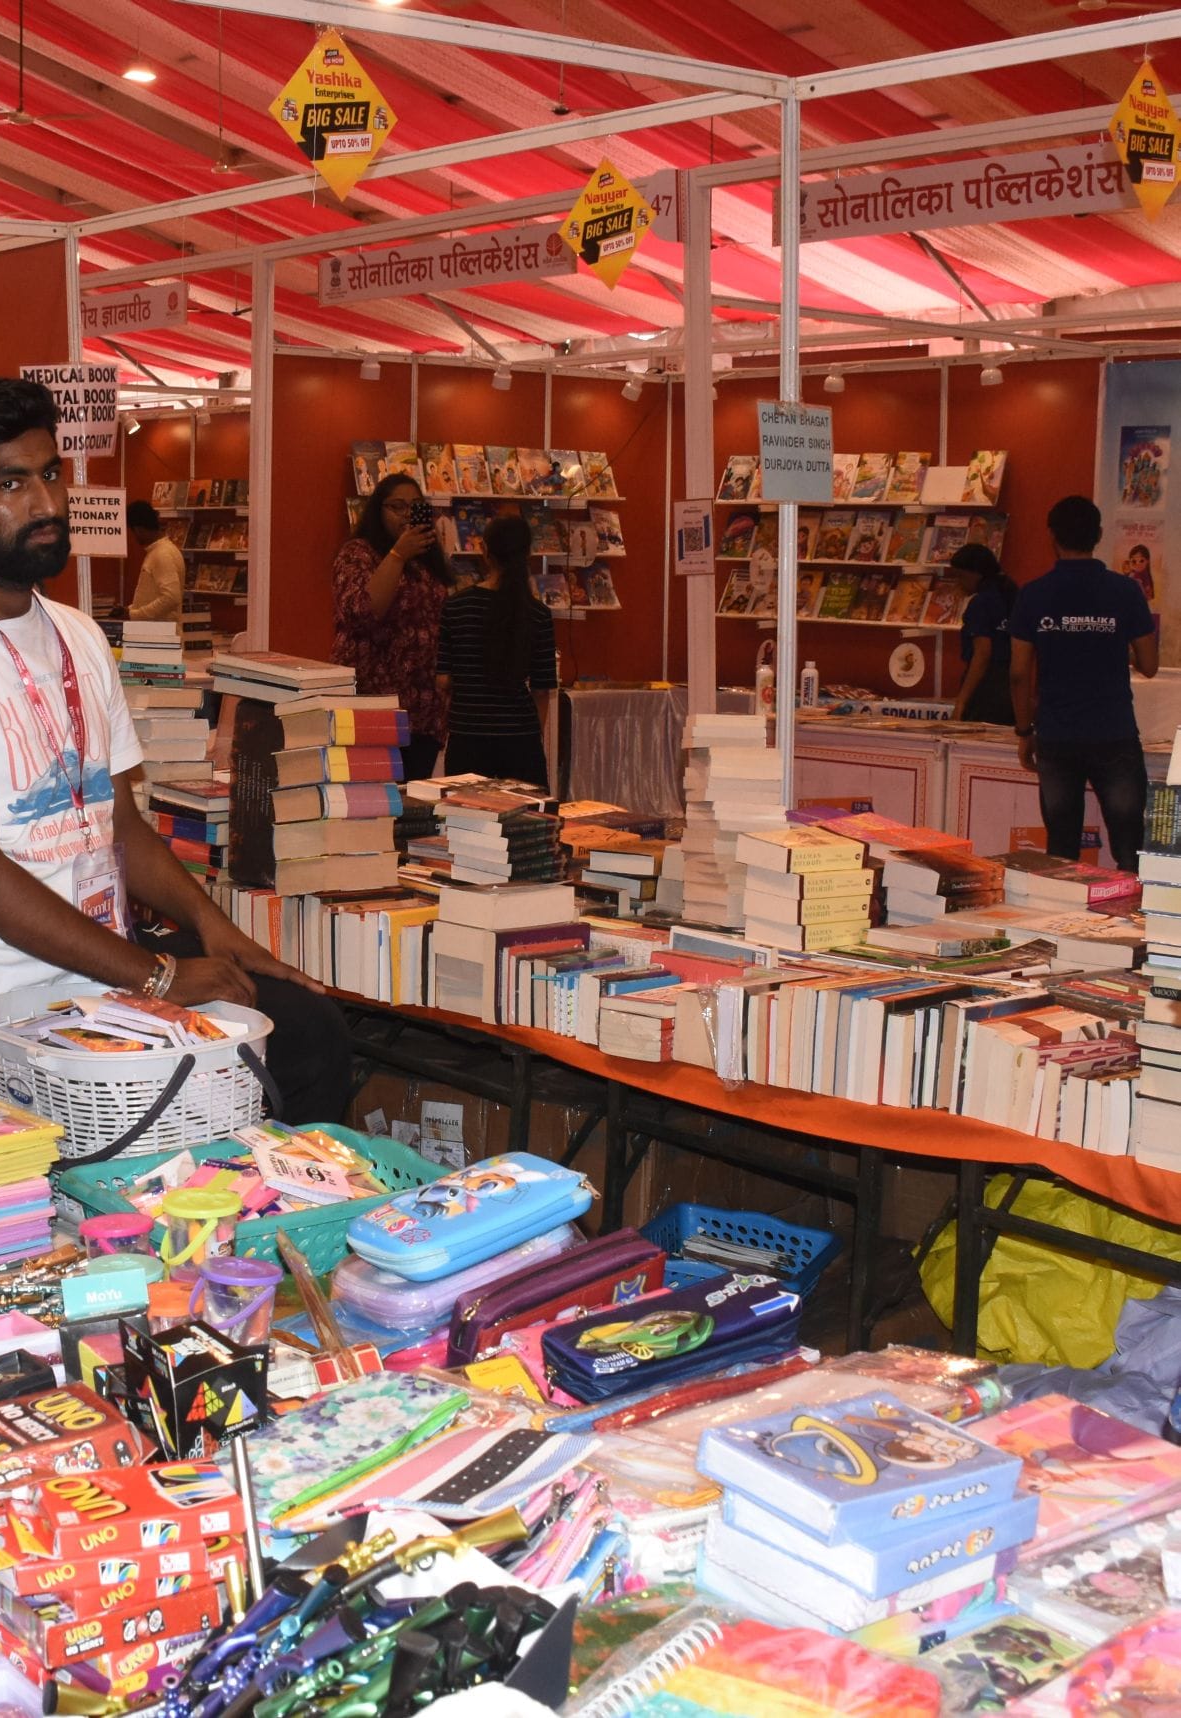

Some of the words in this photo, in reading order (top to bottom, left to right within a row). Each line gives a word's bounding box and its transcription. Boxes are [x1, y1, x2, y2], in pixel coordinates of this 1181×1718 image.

[306, 69, 362, 88] Yashika
[315, 88, 355, 99] Enterprises
[307, 108, 330, 127] BIG
[334, 106, 366, 126] SALE
[331, 140, 347, 149] UPTO
[1130, 134, 1146, 152] BIG
[1148, 136, 1170, 155] SALE
[584, 188, 628, 205] Nayyar
[818, 177, 954, 229] सोनालिका
[964, 154, 1126, 209] पब्लिकेशंस
[585, 221, 604, 240] BIG
[606, 211, 630, 234] SALE
[347, 252, 433, 290] सोनालिका
[439, 236, 539, 278] पब्लिकेशंस
[102, 294, 151, 329] ज्ञानपीठ
[23, 367, 85, 384] MEDICAL
[88, 367, 116, 383] BOOK
[54, 389, 80, 405] TAL
[84, 388, 116, 404] BOOKS
[59, 405, 89, 423] MACY
[91, 405, 116, 421] BOOKS
[761, 411, 796, 425] CHETAN
[799, 415, 829, 428] BHAGAT
[63, 433, 113, 451] DISCOUNT
[762, 435, 805, 449] RAVINDER
[808, 438, 831, 450] SINGH
[764, 458, 803, 472] DURJOYA
[806, 460, 831, 473] DUTTA
[84, 497, 121, 506] LETTER
[68, 511, 119, 521] CTIONARY
[68, 526, 122, 536] MPETITION
[1061, 616, 1116, 627] SONALIKA
[32, 847, 55, 862] how
[86, 1289, 122, 1304] MoYu
[34, 1392, 104, 1431] UNO
[45, 1476, 128, 1521] UNO
[79, 1526, 118, 1552] UNO
[36, 1564, 76, 1590] UNO
[100, 1581, 135, 1610] UNO
[65, 1621, 102, 1643] UNO
[65, 1645, 79, 1657] NO
[118, 1642, 155, 1677] UNO
